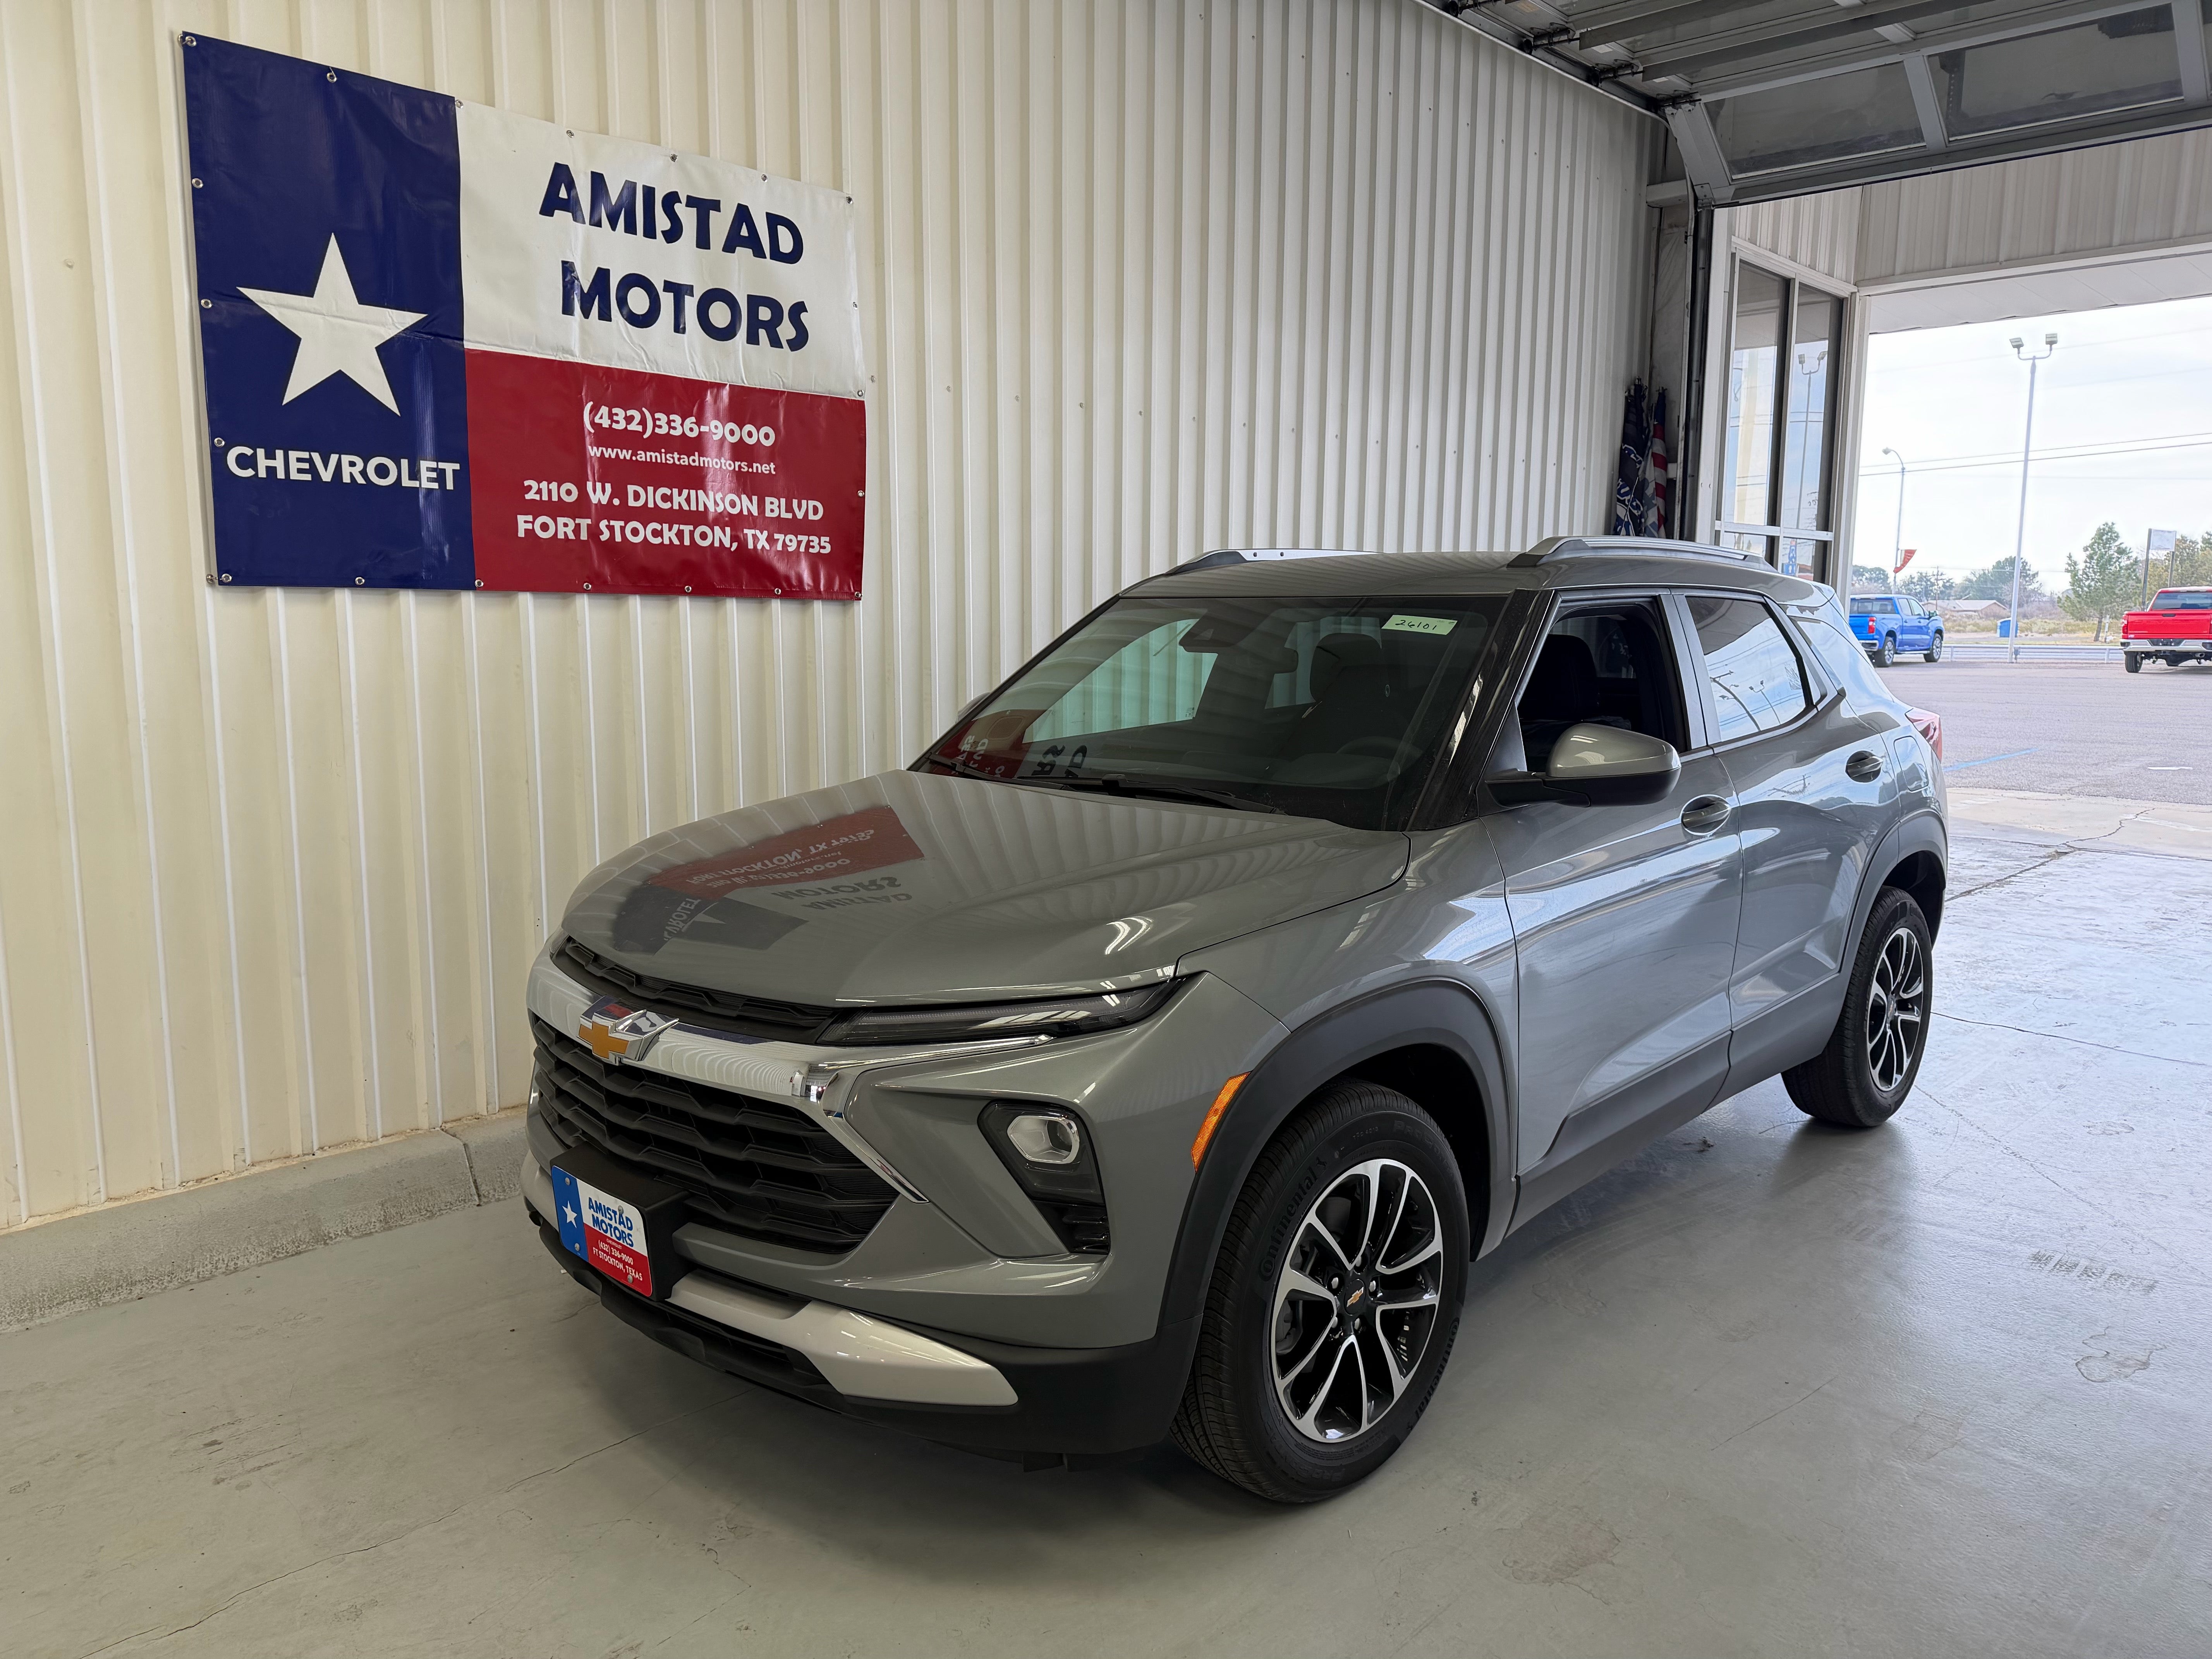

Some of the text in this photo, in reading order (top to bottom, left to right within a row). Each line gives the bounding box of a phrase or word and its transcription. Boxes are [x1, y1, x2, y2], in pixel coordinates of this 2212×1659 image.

[539, 162, 804, 265] AMISTAD
[562, 261, 809, 352] MOTORS
[584, 402, 776, 447] (432)336-9000
[227, 446, 460, 490] CHEVROLET
[588, 447, 776, 475] www.amistadmotors.net
[524, 481, 823, 520] 2110 W. DICKINSON BLVD
[517, 514, 831, 554] FORT STOCKTON, TX 79735
[588, 1197, 633, 1231] AMISTAD
[592, 1214, 634, 1247] MOTORS
[1259, 1166, 1318, 1282] Continental
[593, 1247, 643, 1281] FT STOCKTON, TEXAS
[598, 1240, 633, 1265] (432) 336-9000
